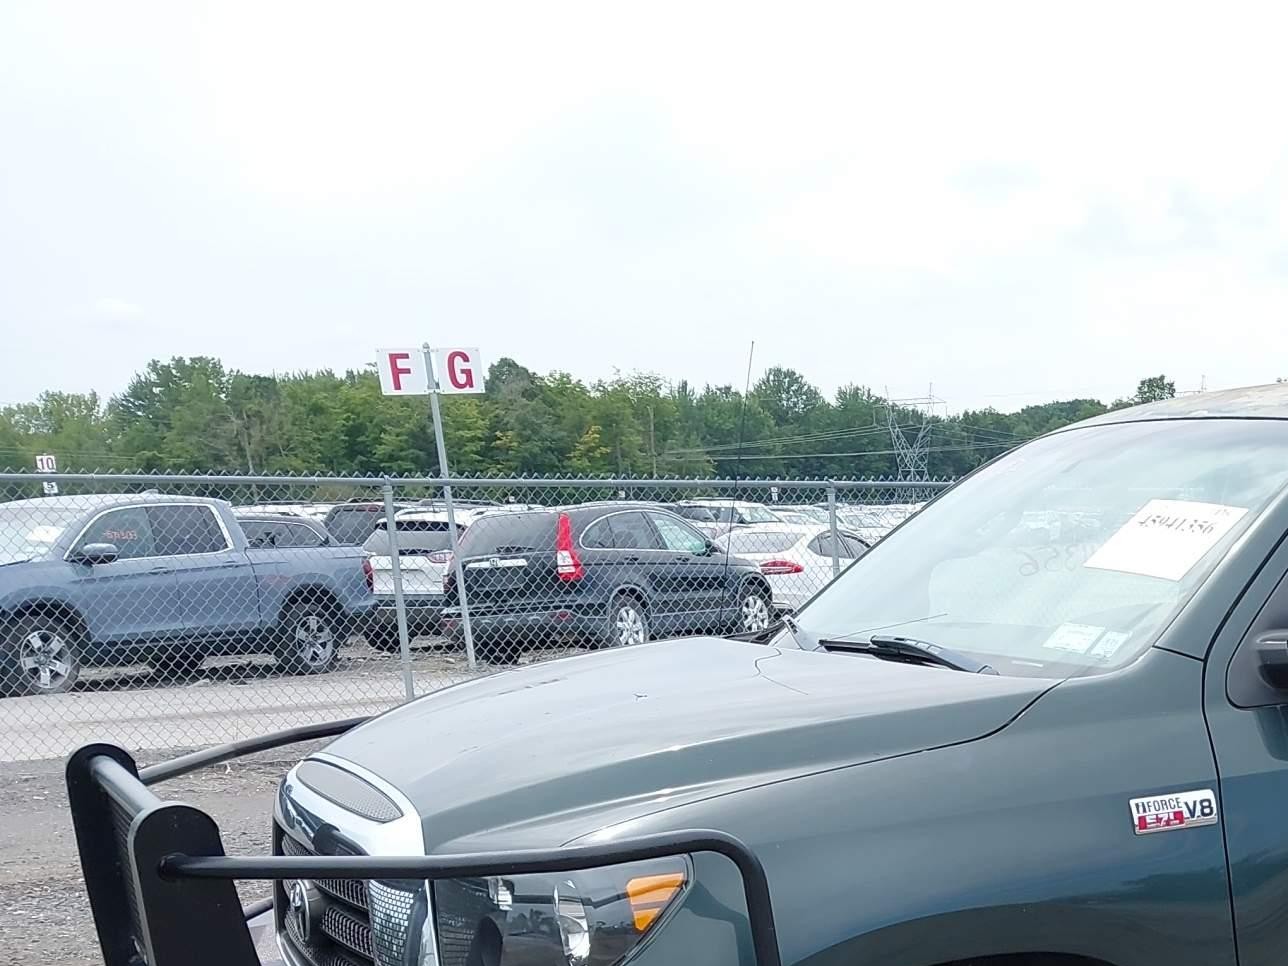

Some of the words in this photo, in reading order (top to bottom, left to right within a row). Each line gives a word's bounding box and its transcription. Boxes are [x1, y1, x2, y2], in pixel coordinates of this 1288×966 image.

[388, 353, 411, 390] F
[447, 351, 474, 389] G
[39, 457, 54, 470] 10
[1184, 798, 1215, 819] V8
